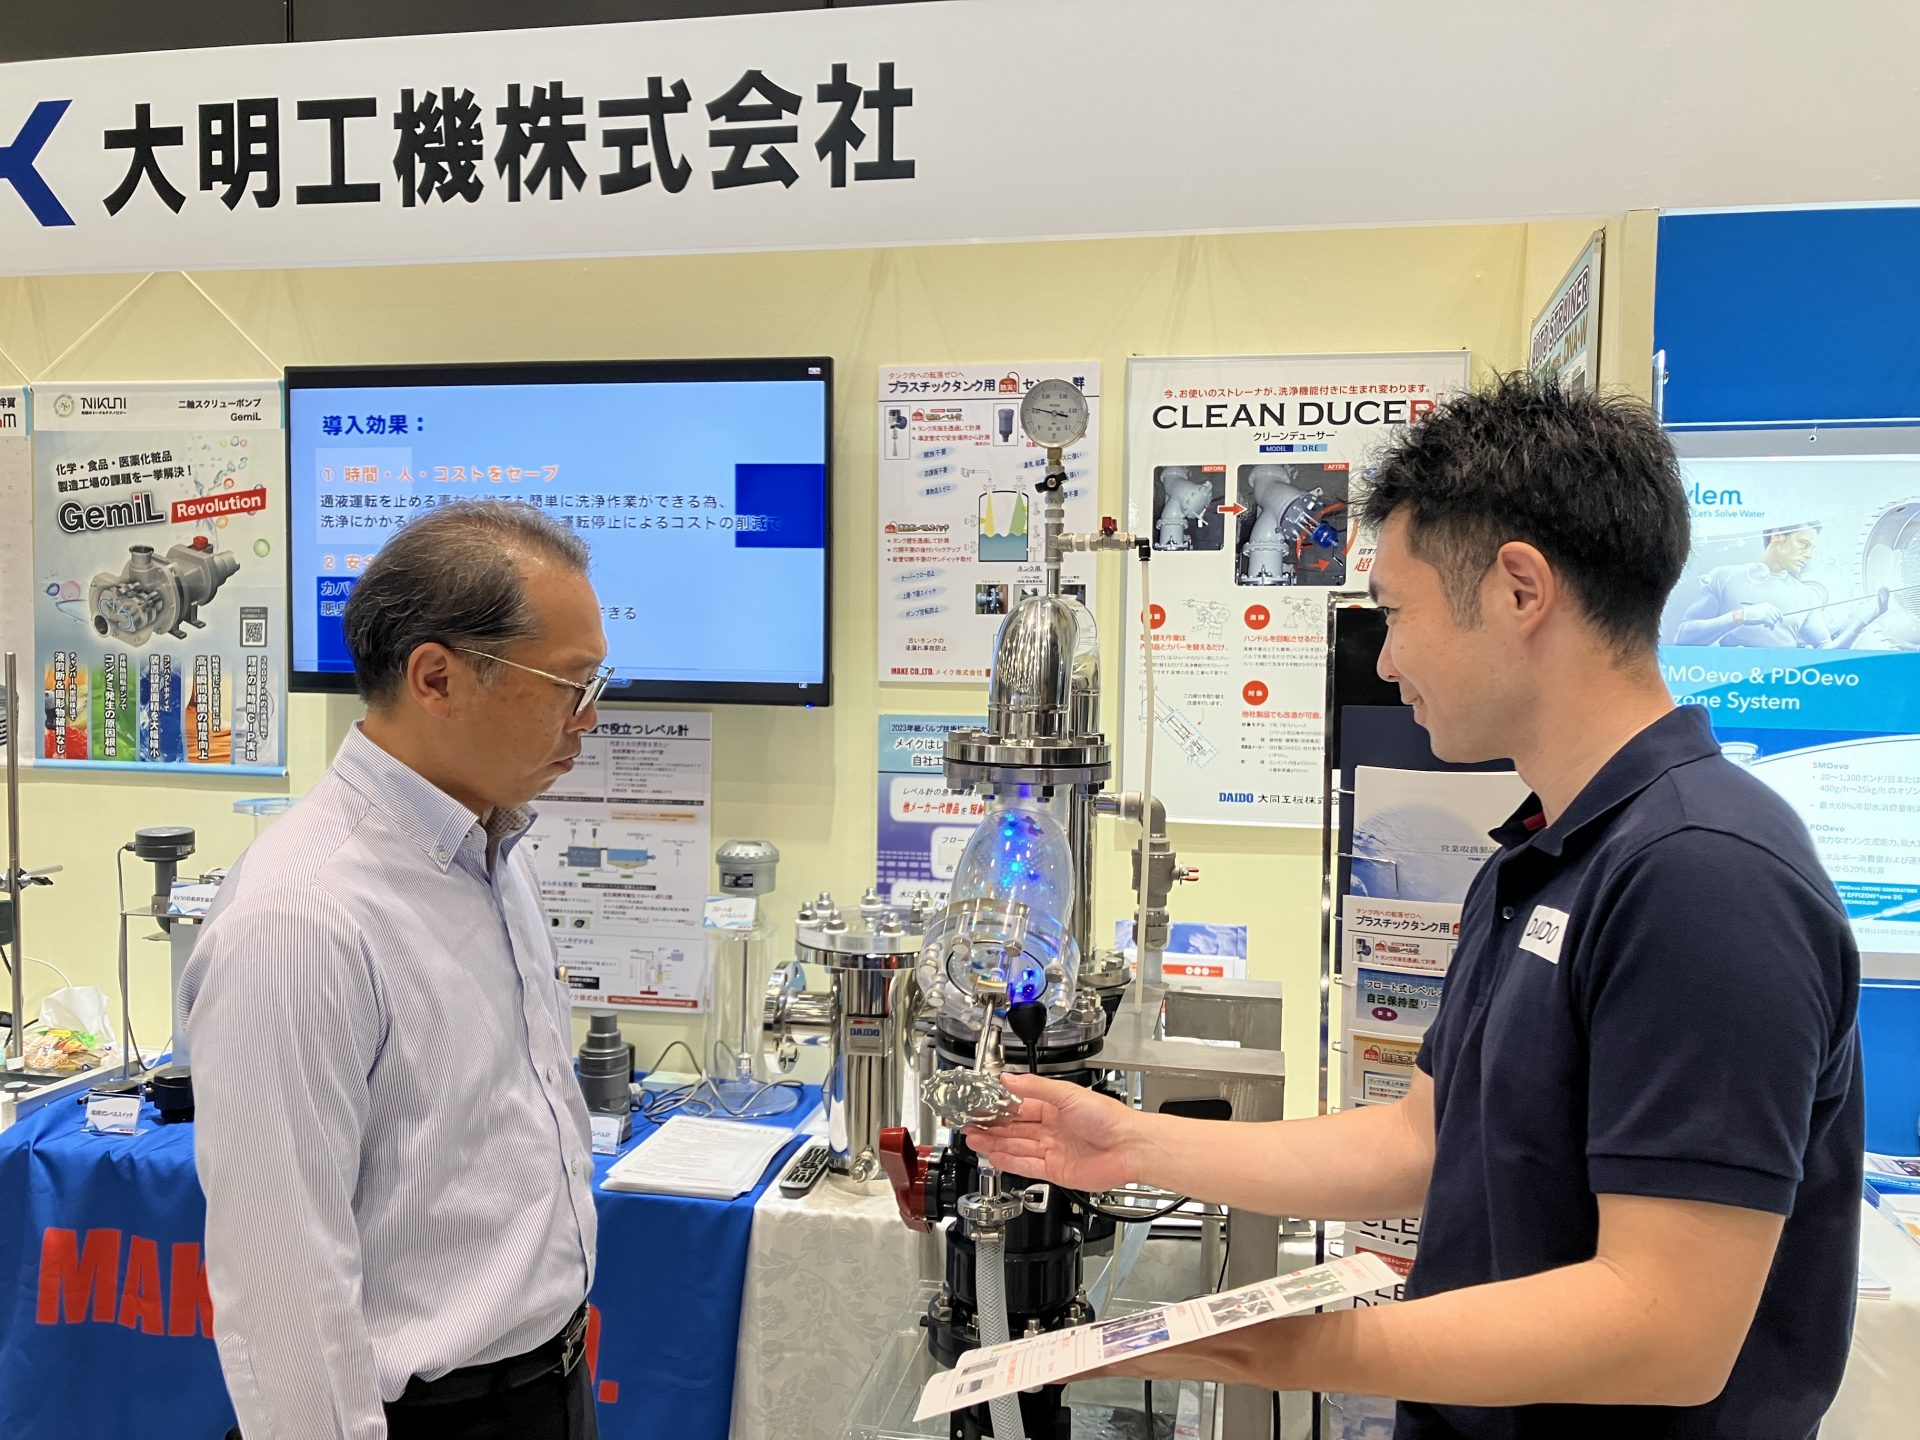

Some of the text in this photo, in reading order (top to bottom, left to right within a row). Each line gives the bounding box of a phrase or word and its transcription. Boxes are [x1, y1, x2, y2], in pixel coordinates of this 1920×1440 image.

[103, 62, 917, 217] 大明工機株式会社
[1549, 266, 1589, 350] STRAINER
[888, 379, 996, 393] プラスチックタンク用
[1164, 384, 1430, 399] 今、お使いのストレーナが、洗浄機能付きに生まれ変わります。
[178, 398, 262, 410] 二軸スクリューポンプ
[230, 413, 262, 421] GemiL
[1152, 399, 1436, 429] CLEAN DUCER
[322, 414, 425, 435] 導入効果：
[1253, 430, 1336, 442] クリーンデューサー
[1265, 444, 1320, 453] MODEL DRE
[56, 451, 173, 476] 化学・食品・医薬化粧品
[1203, 465, 1225, 473] BEFORE
[57, 465, 192, 493] 製造工場の課題を一挙解決！
[344, 464, 559, 483] 時間・人・コストをセーブ
[59, 492, 262, 532] GemiL Revolution
[1715, 509, 1738, 518] Solve
[1740, 509, 1766, 518] Water
[936, 669, 983, 677] メイク株式会社
[1749, 667, 1765, 685] &
[1771, 668, 1859, 687] PDOevo
[1727, 692, 1800, 714] System
[1812, 761, 1849, 770] SMOevo
[1219, 792, 1254, 803] DAIDO
[1356, 916, 1450, 934] プラスチックタンク用
